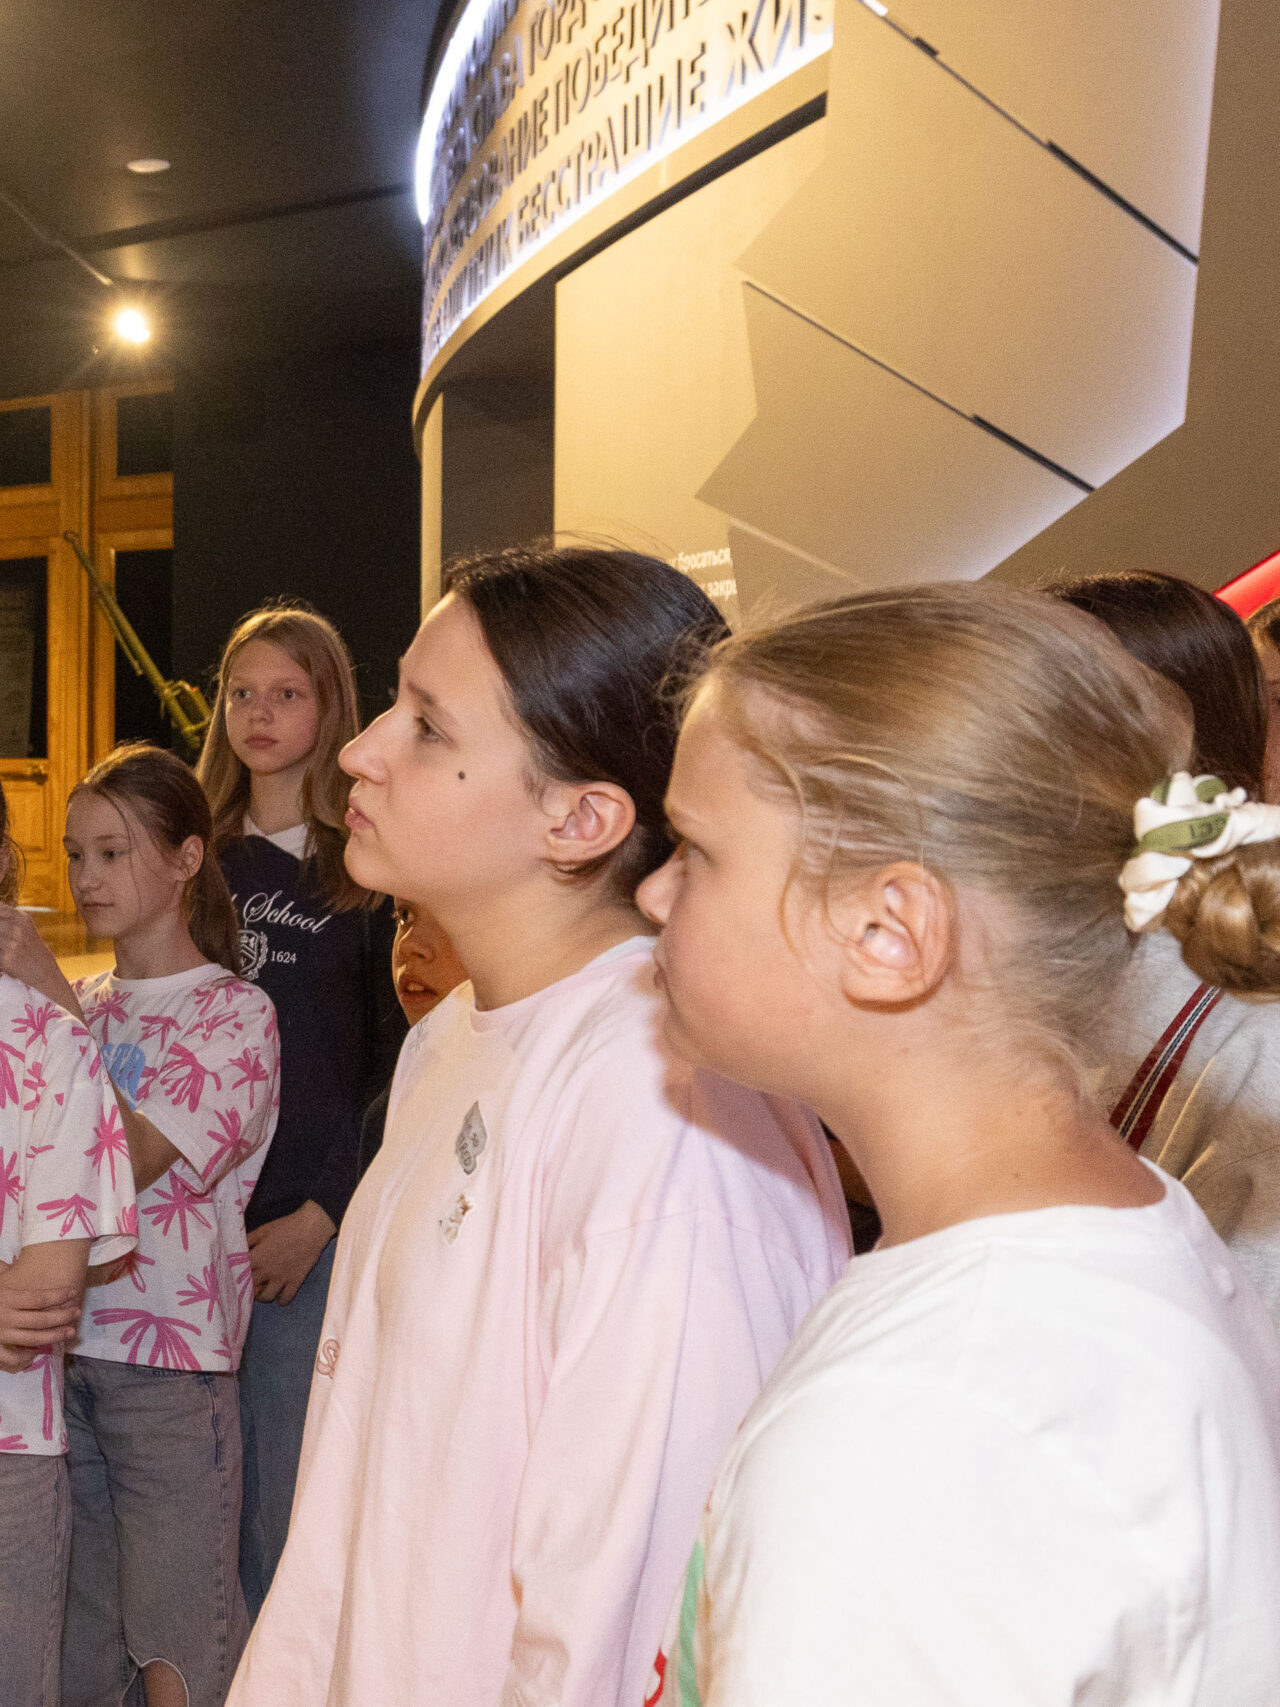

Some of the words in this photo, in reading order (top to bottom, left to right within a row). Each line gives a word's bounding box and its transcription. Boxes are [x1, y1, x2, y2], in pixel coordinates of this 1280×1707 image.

[520, 40, 706, 245] БЕССТРАШИЕ
[723, 0, 824, 98] ЖИ
[243, 890, 332, 933] School
[271, 951, 297, 964] 1624
